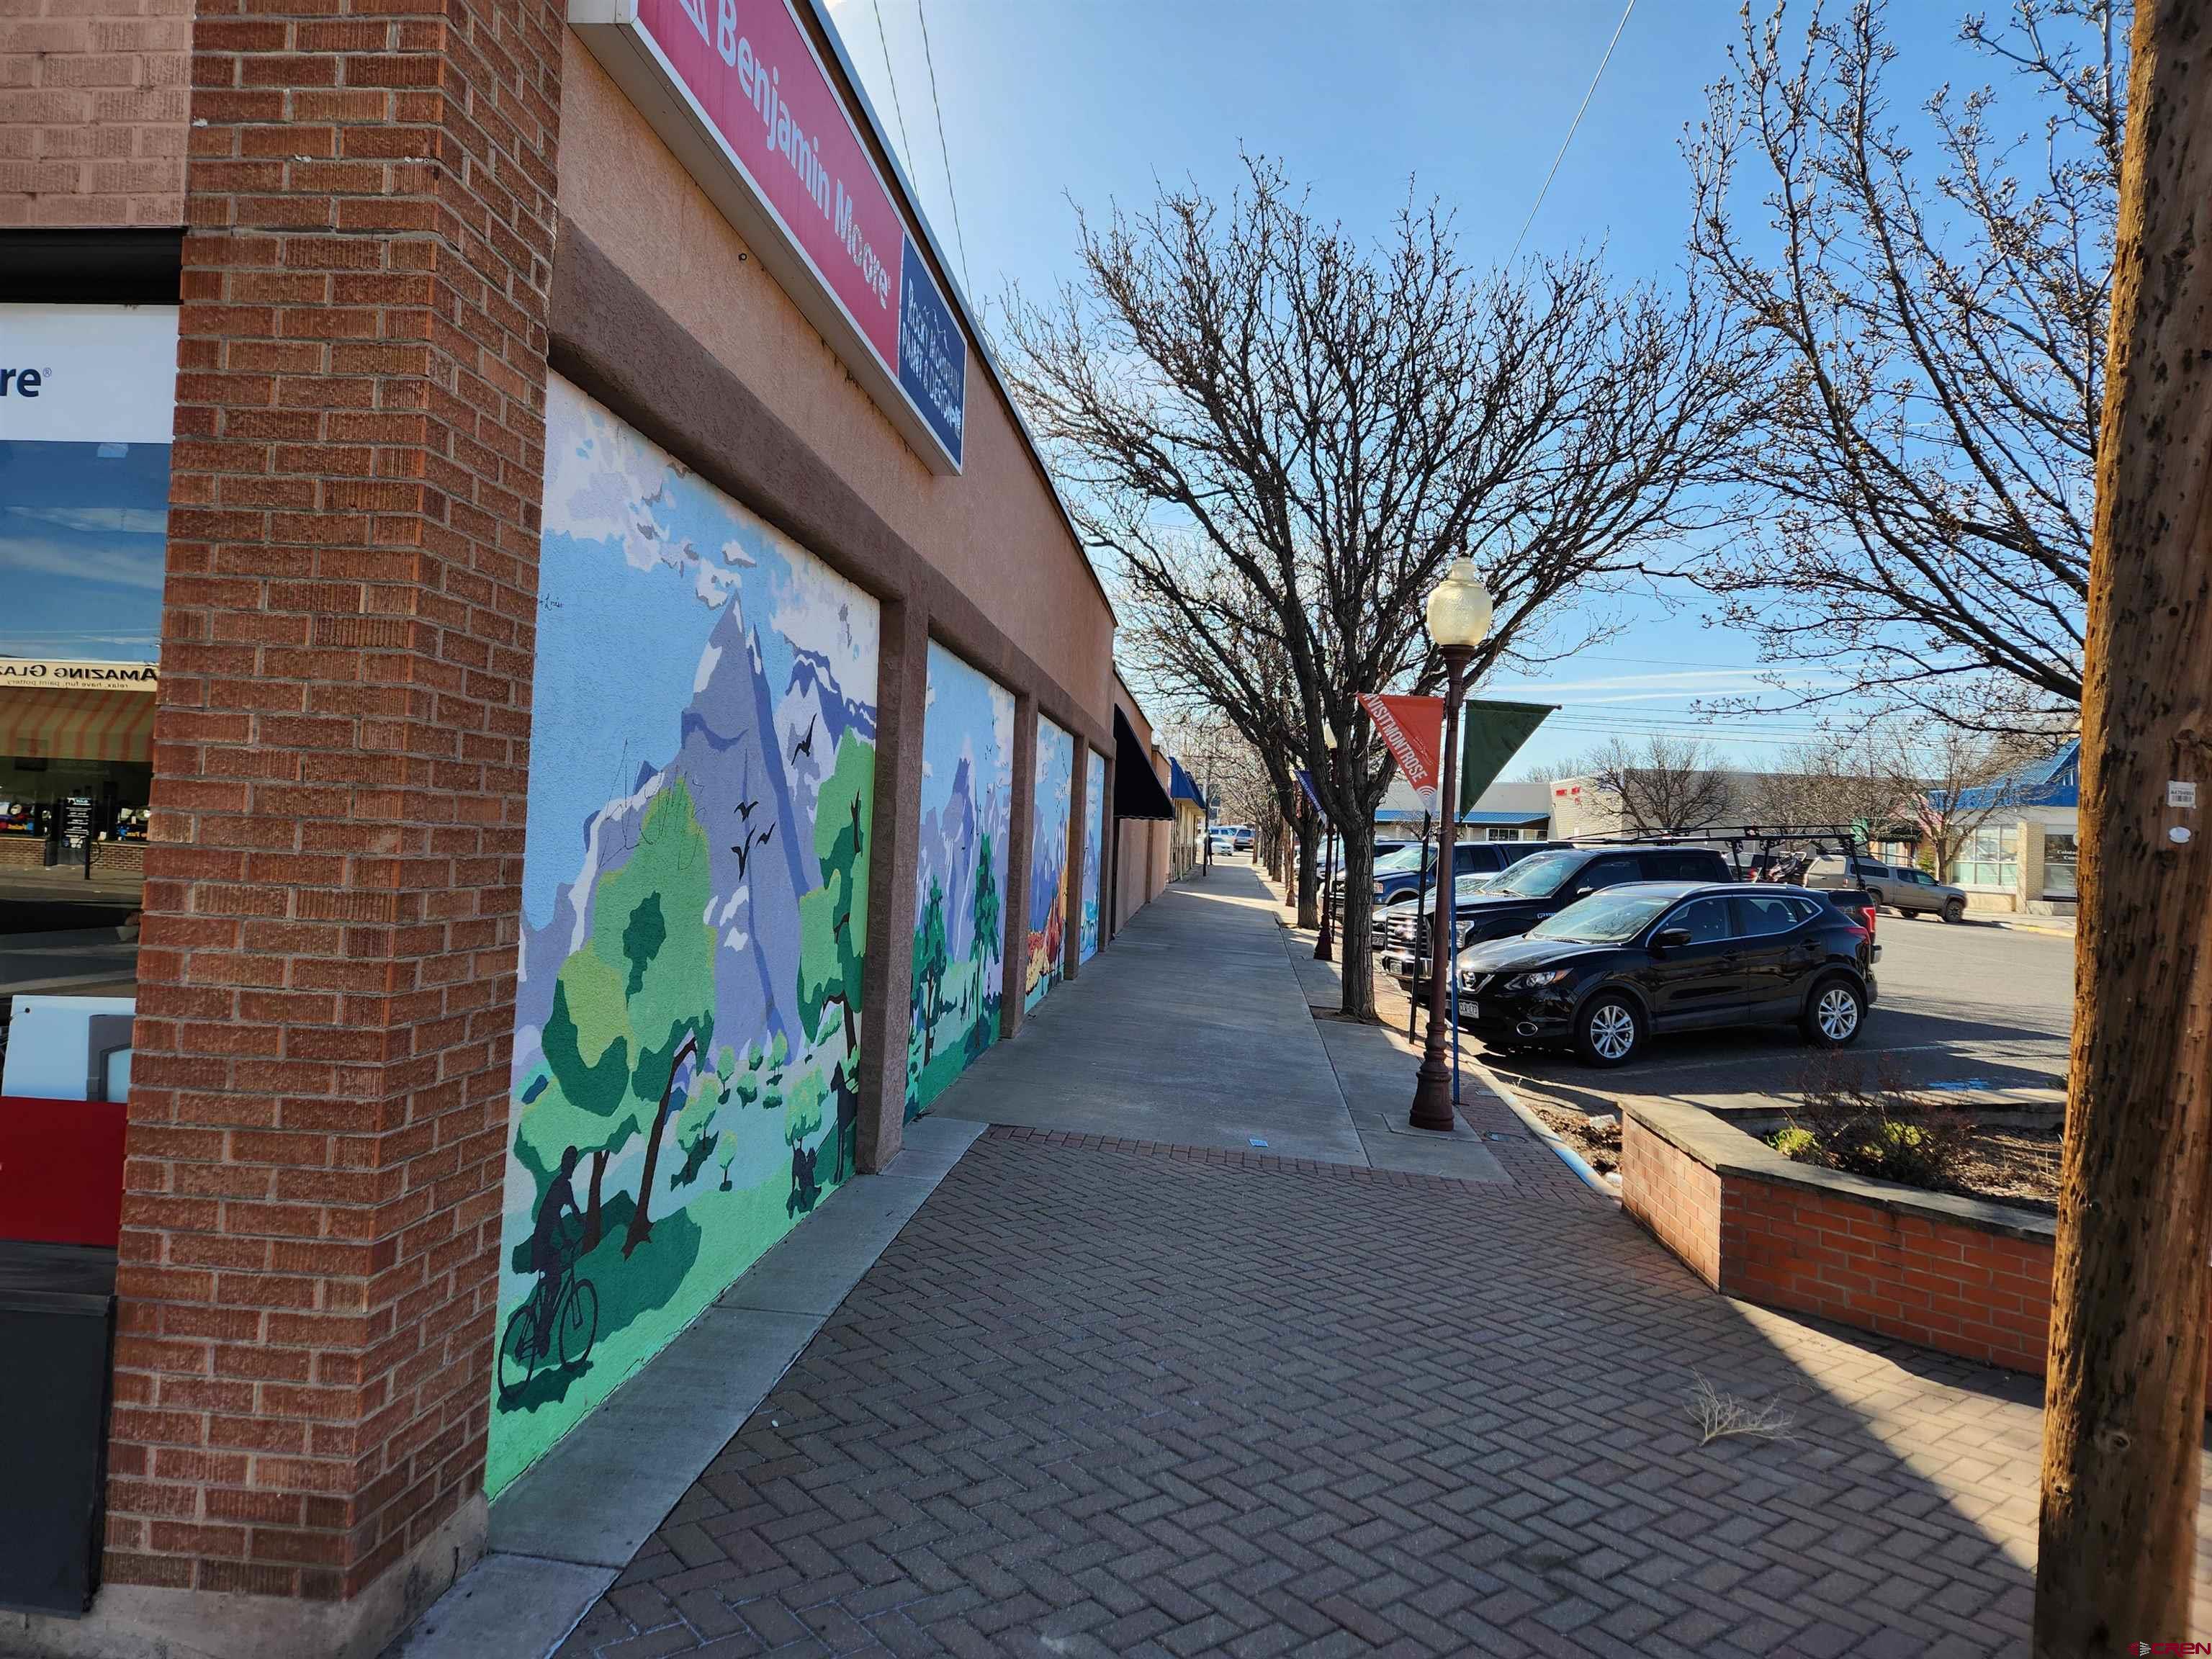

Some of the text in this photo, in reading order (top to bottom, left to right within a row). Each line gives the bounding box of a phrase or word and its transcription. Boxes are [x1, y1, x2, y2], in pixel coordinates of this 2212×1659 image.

[717, 0, 830, 220] Benjamin
[902, 320, 924, 382] PAINT
[1362, 693, 1429, 783] #VISITMONTROSE
